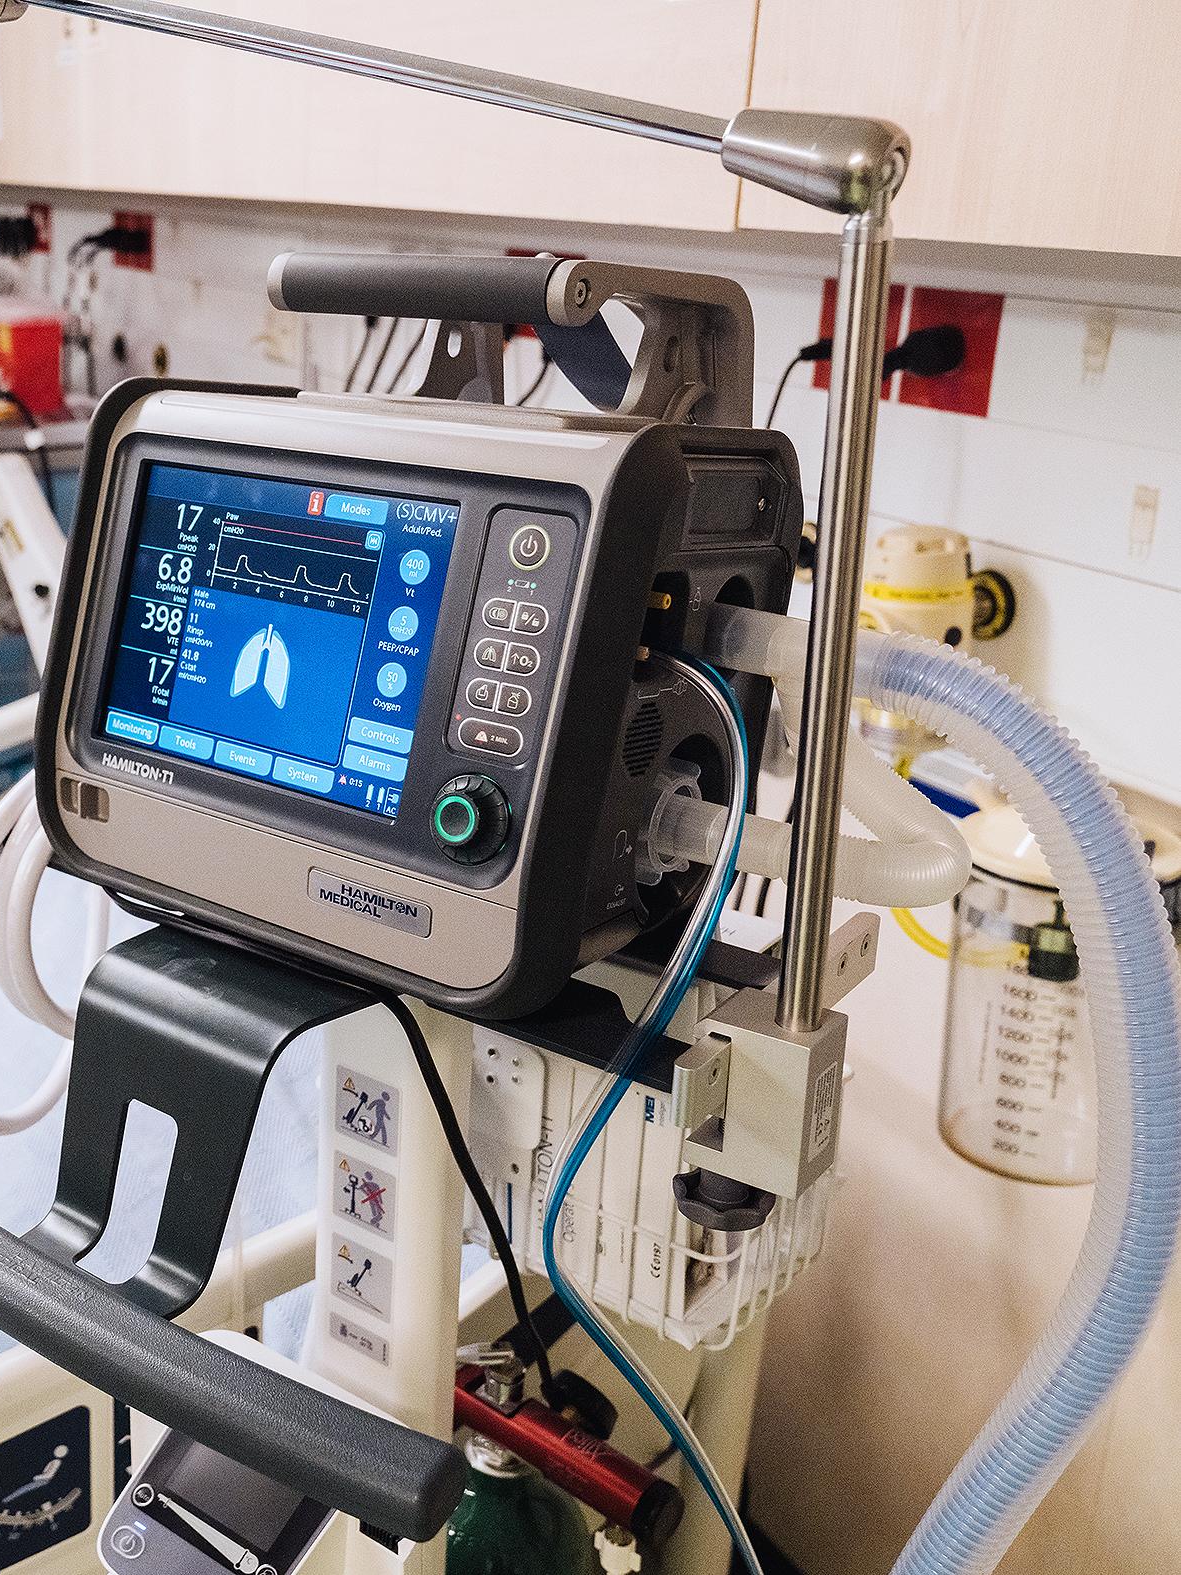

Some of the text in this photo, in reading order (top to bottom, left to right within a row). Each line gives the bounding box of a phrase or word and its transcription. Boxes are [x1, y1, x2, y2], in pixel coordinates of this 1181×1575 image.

[341, 502, 371, 516] Modes
[396, 502, 457, 524] (S)CMV+
[177, 503, 203, 531] 17
[226, 512, 239, 521] Paw
[179, 532, 199, 543] Ppeak
[402, 523, 442, 538] Adult/Ped.
[208, 543, 216, 552] 20
[159, 553, 193, 584] 6.8
[406, 558, 424, 571] 400
[206, 569, 211, 577] 0
[156, 581, 189, 595] ExpMinVol
[194, 589, 209, 599] Male
[405, 587, 416, 597] Vt
[194, 598, 216, 610] 174 cm
[232, 581, 237, 589] 2
[303, 595, 308, 603] 8
[327, 600, 335, 608] 10
[352, 605, 360, 613] 12
[140, 602, 183, 636] 398
[190, 612, 198, 624] 11
[400, 615, 408, 626] 5
[187, 625, 204, 637] Rinsp
[167, 636, 179, 647] VTE
[182, 649, 199, 661] 41.8
[378, 641, 419, 657] PEEP/CPAP
[148, 656, 175, 685] 17
[180, 661, 196, 672] Cstat
[386, 671, 398, 683] 50
[372, 698, 401, 712] Oxygen
[112, 718, 153, 740] Monitoring
[361, 726, 400, 745] Controls
[174, 735, 196, 750] Tools
[229, 750, 257, 767] Events
[358, 754, 391, 772] Alarms
[287, 766, 318, 784] System
[348, 778, 363, 787] 0:15
[386, 806, 397, 815] AC
[319, 888, 382, 919] MEDICAL
[341, 883, 418, 918] HAMILTON
